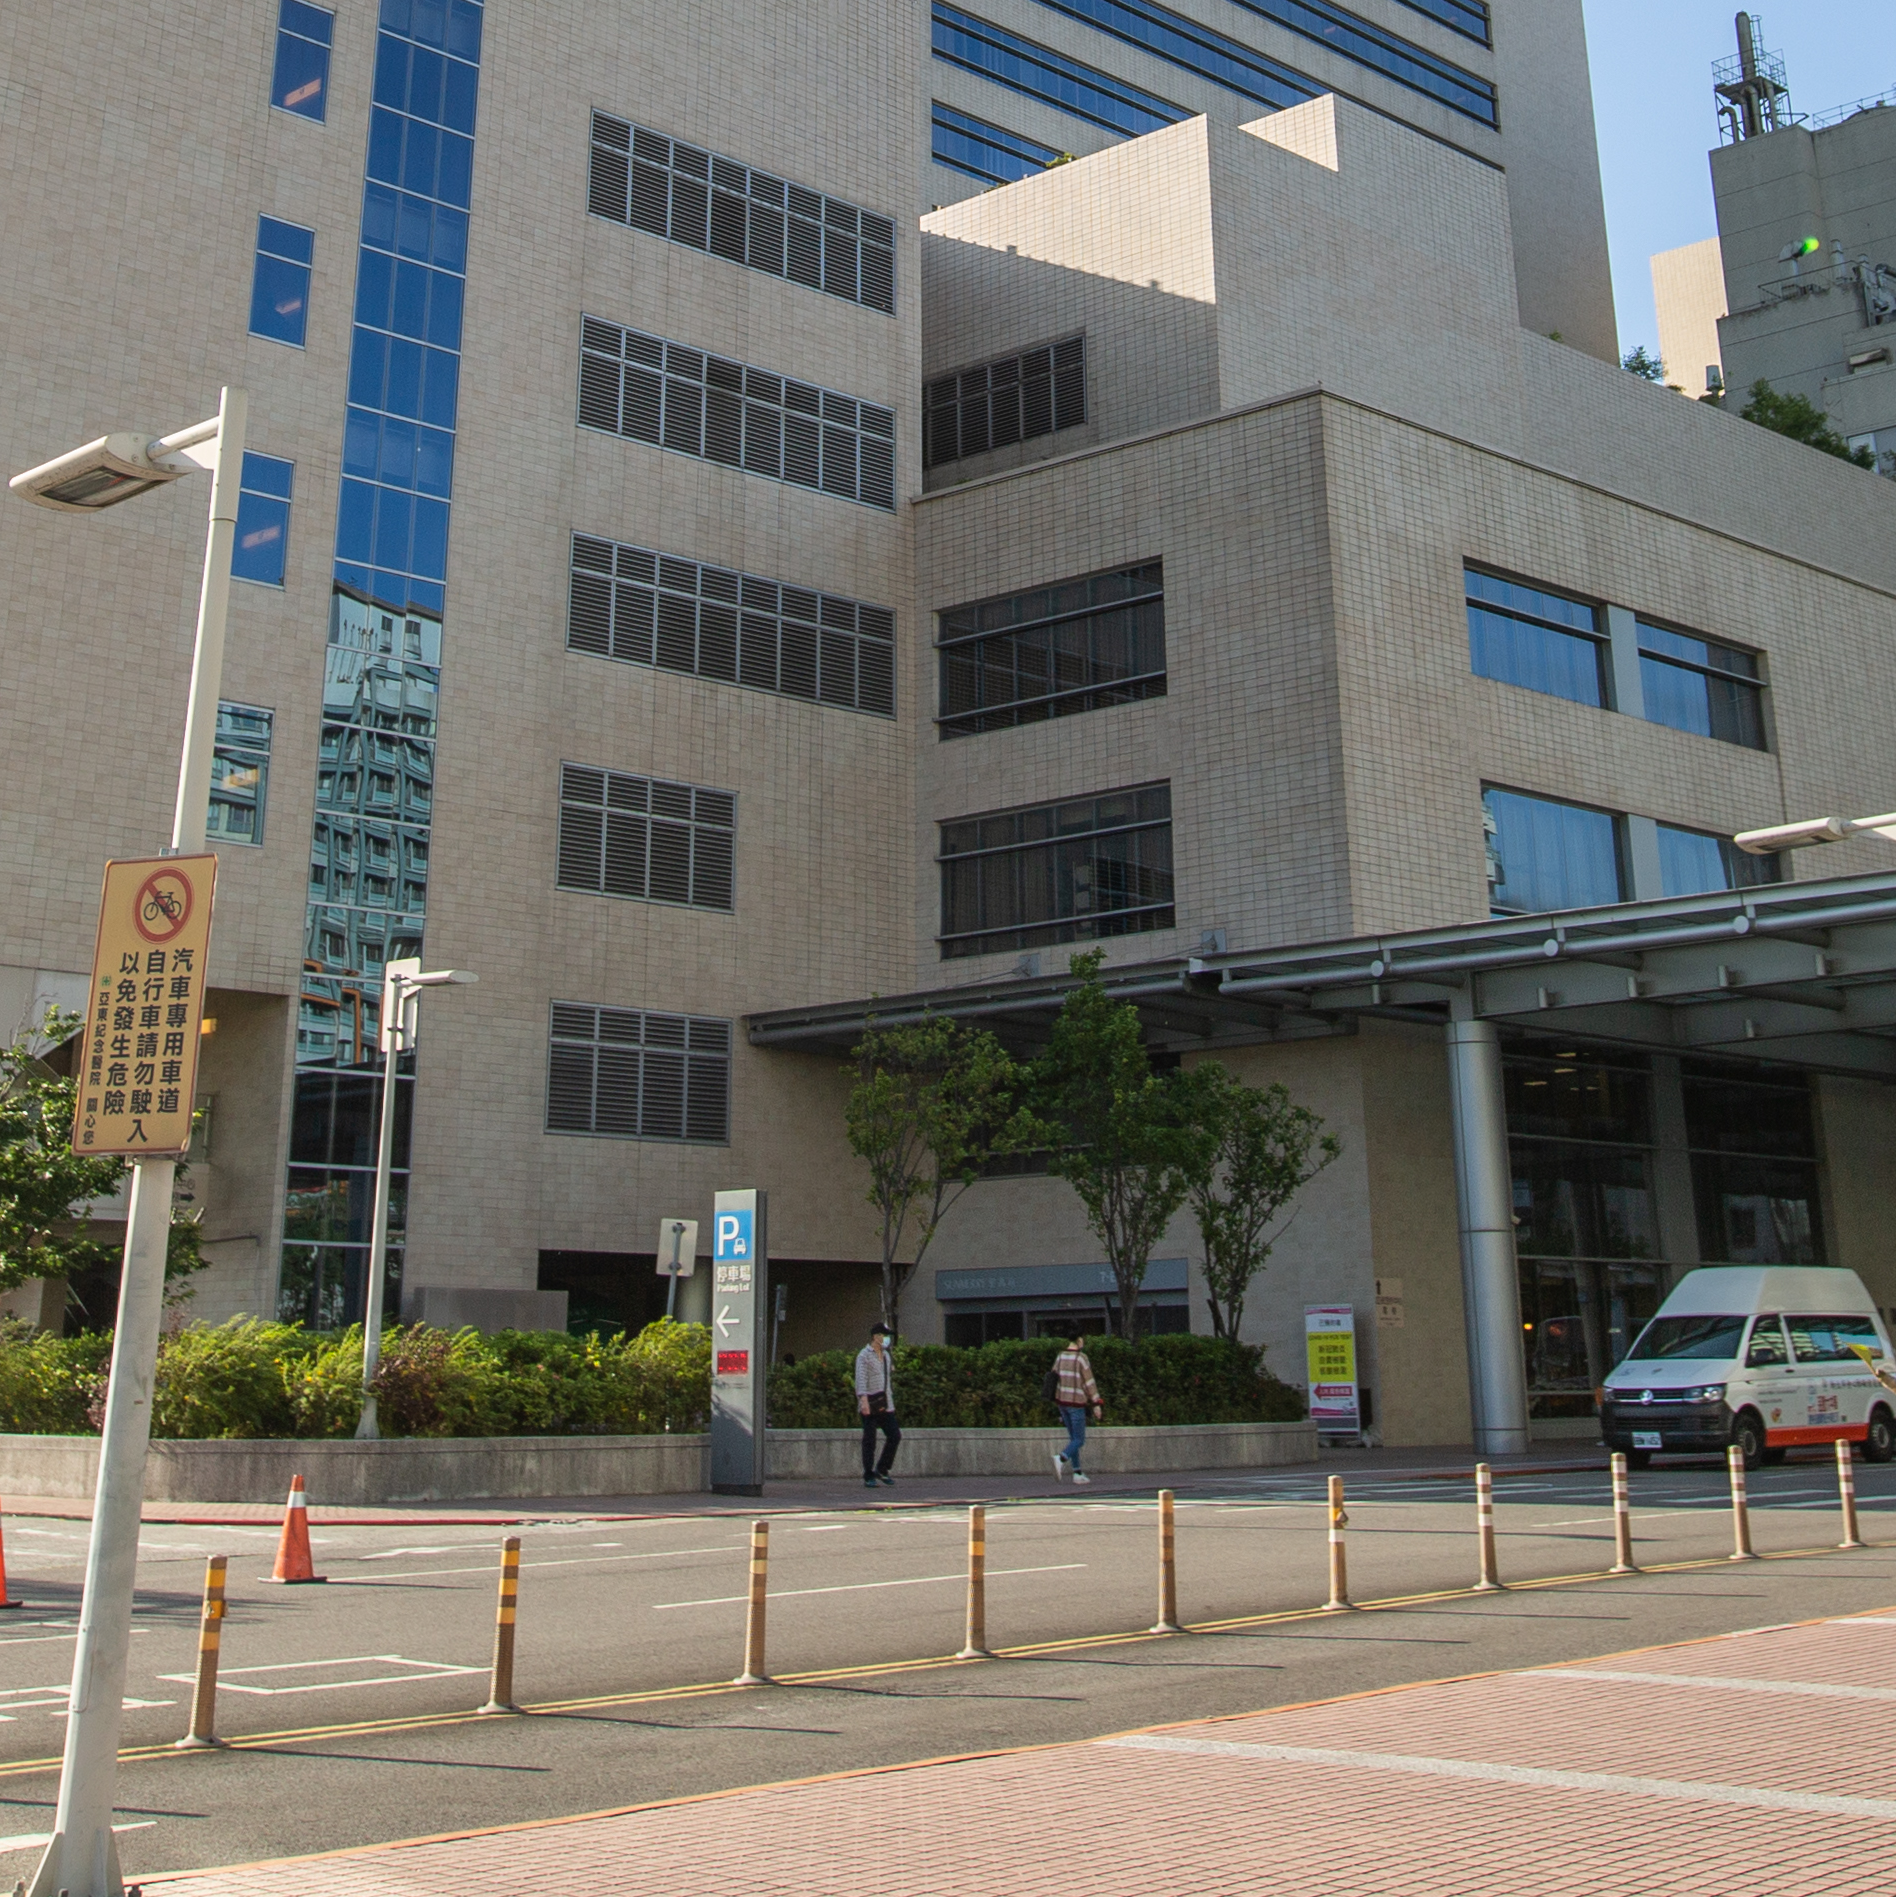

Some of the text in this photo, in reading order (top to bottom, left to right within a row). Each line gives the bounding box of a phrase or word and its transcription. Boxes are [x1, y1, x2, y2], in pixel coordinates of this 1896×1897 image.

[89, 992, 110, 1086] 亞東紀念醫院
[103, 951, 140, 1116] 以免發生危險
[127, 949, 167, 1143] 自行車請勿駛入
[156, 948, 195, 1114] 汽車專用車道
[717, 1265, 751, 1282] 停車場
[718, 1215, 740, 1256] P
